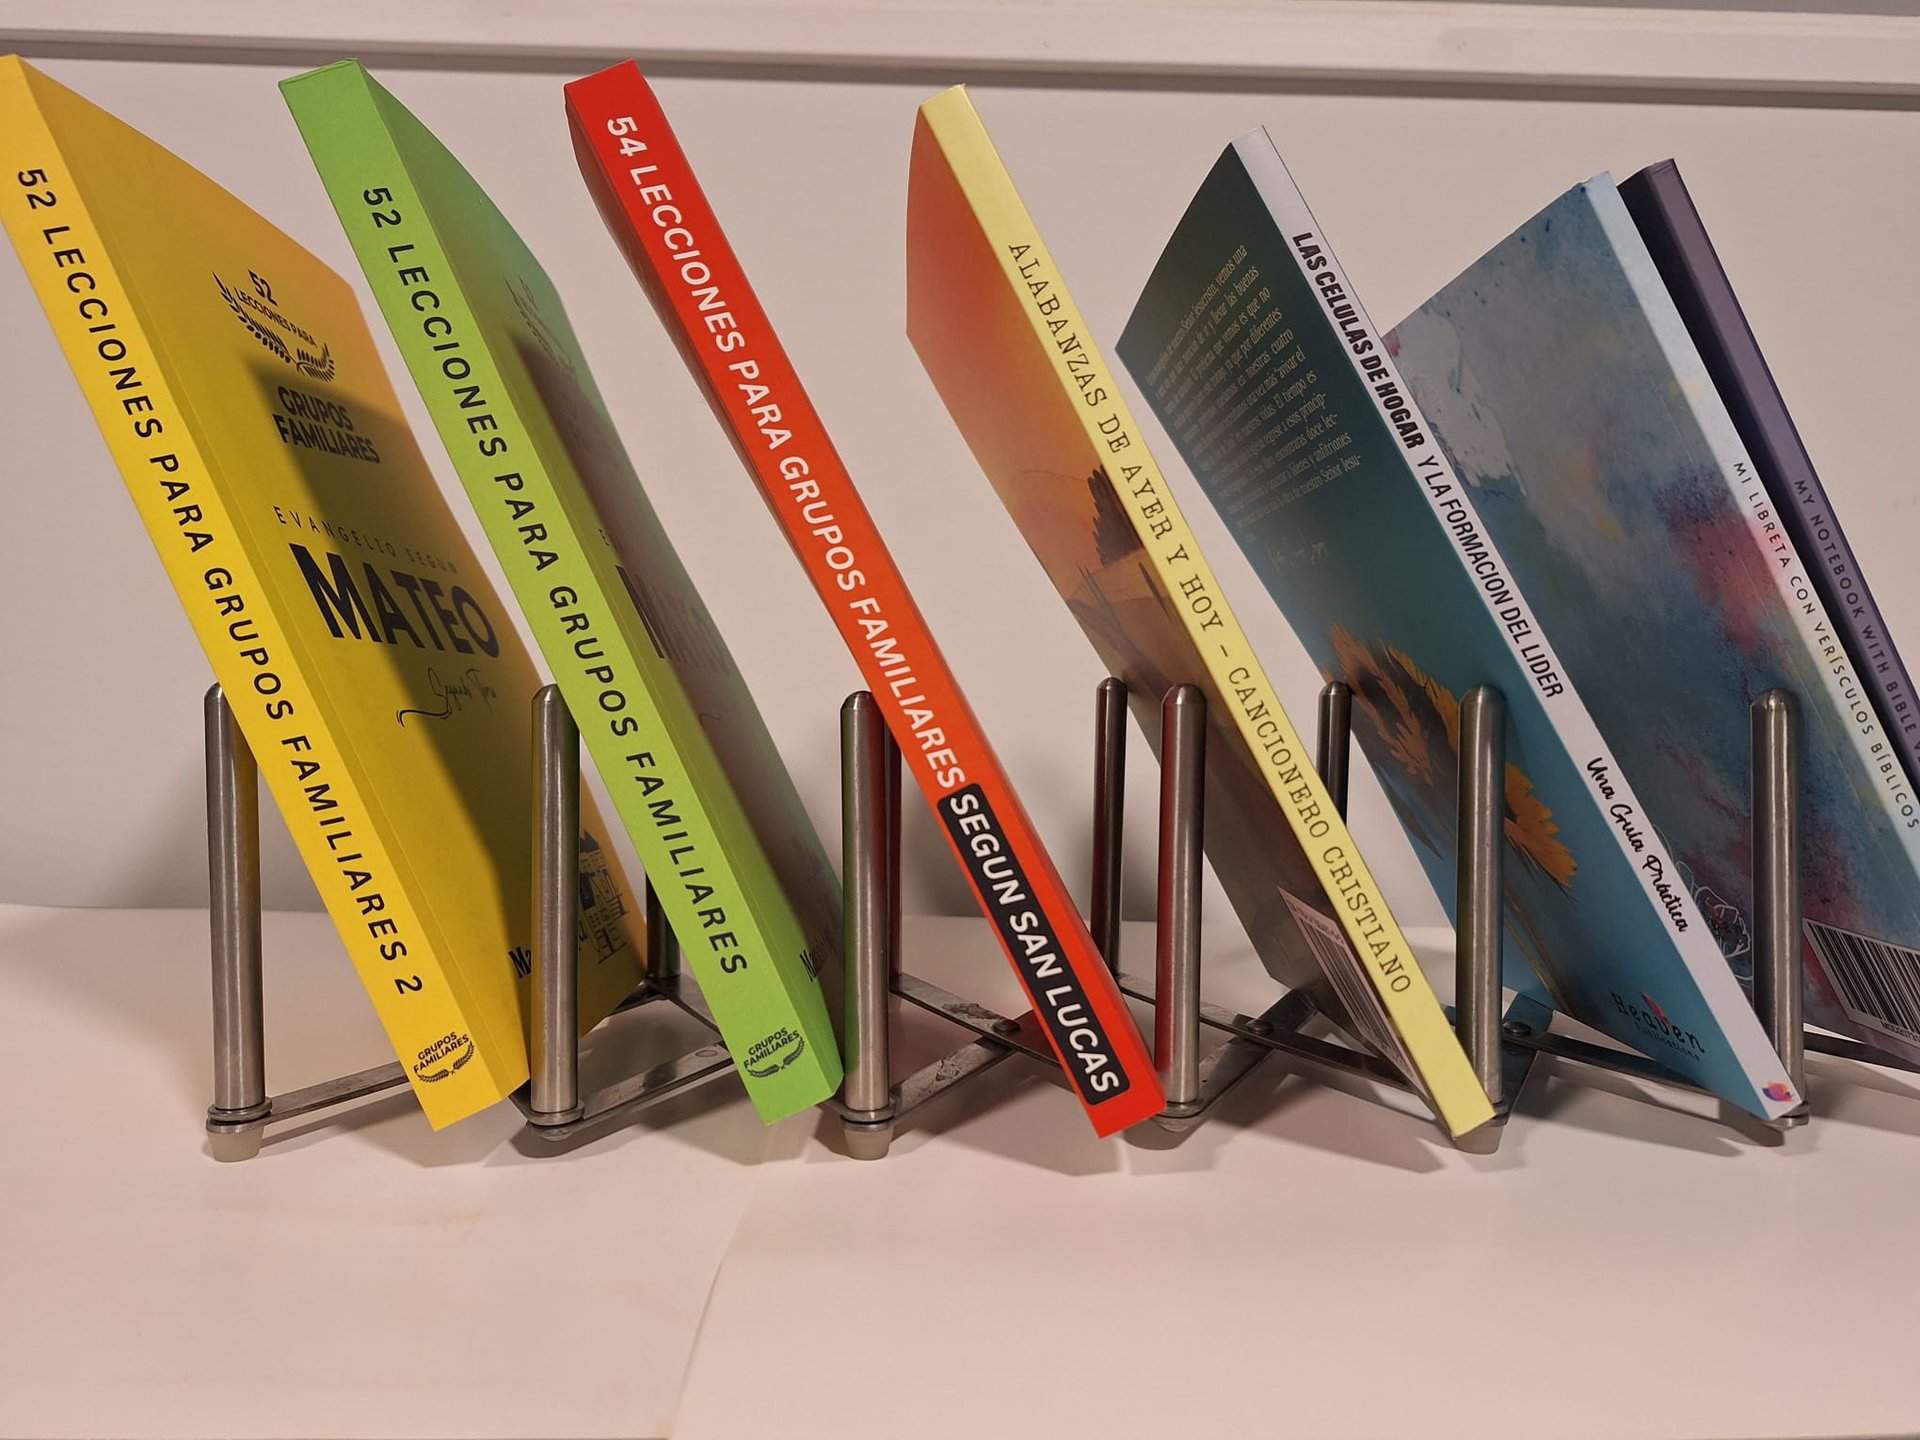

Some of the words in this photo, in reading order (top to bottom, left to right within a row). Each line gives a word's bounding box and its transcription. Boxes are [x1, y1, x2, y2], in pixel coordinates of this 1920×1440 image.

[1293, 232, 1327, 271] LAS
[248, 270, 278, 306] 52
[1234, 265, 1259, 296] buenas
[234, 287, 291, 331] LECCIONES
[1249, 307, 1282, 344] diferentes
[1314, 271, 1374, 355] CELULAS
[1270, 328, 1294, 354] cuatro
[1281, 378, 1307, 402] tiempo
[1360, 354, 1390, 383] DE
[278, 386, 354, 431] GRUPOS
[1375, 381, 1425, 449] HOGAR
[272, 414, 380, 463] FAMILIARES
[607, 116, 647, 157] 54
[630, 165, 744, 352] LECCIONES
[729, 360, 792, 450] PARA
[780, 456, 865, 591] GRUPOS
[850, 597, 965, 788] FAMILIARES
[1417, 455, 1438, 469] Y
[1425, 471, 1451, 498] LA
[273, 505, 397, 559] EVANGELIO
[407, 548, 457, 575] SEGUN
[1440, 498, 1514, 605] FORMACION
[18, 168, 57, 210] 52
[43, 226, 163, 438] LECCIONES
[150, 453, 214, 553] PARA
[204, 568, 294, 719] GRUPOS
[282, 736, 407, 961] FAMILIARES
[394, 975, 423, 994] 2
[288, 543, 499, 658] MATEO
[363, 187, 401, 228] 52
[388, 244, 507, 458] LECCIONES
[494, 472, 559, 572] PARA
[549, 586, 638, 736] GRUPOS
[626, 752, 747, 974] FAMILIARES
[1008, 243, 1107, 406] ALABANZAS
[1098, 414, 1130, 453] DE
[1121, 464, 1172, 540] AYER
[1167, 544, 1189, 565] Y
[1179, 573, 1224, 631] HOY
[1228, 667, 1330, 838] CANCIONERO
[1323, 846, 1411, 993] CRISTIANO
[1500, 607, 1532, 644] DEL
[1794, 479, 1815, 505] MY
[1810, 514, 1866, 619] NOTEBOOK
[1861, 625, 1889, 674] WITH
[1886, 681, 1917, 733] BIBLE
[1733, 462, 1752, 484] MI
[1749, 491, 1791, 568] LIBRETA
[1790, 575, 1815, 615] CON
[1814, 622, 1874, 735] VERÍSCULOS
[1870, 742, 1920, 828] BÍBLICOS
[1521, 644, 1564, 698] LIDER
[1587, 757, 1614, 800] Una
[950, 793, 1026, 905] SEGUN
[1009, 911, 1062, 978] SAN
[1046, 985, 1119, 1093] LUCAS
[413, 1034, 469, 1073] FAMILIARES
[417, 1031, 457, 1061] GRUPOS
[743, 1029, 800, 1069] FAMILIARES
[748, 1027, 788, 1056] GRUPOS
